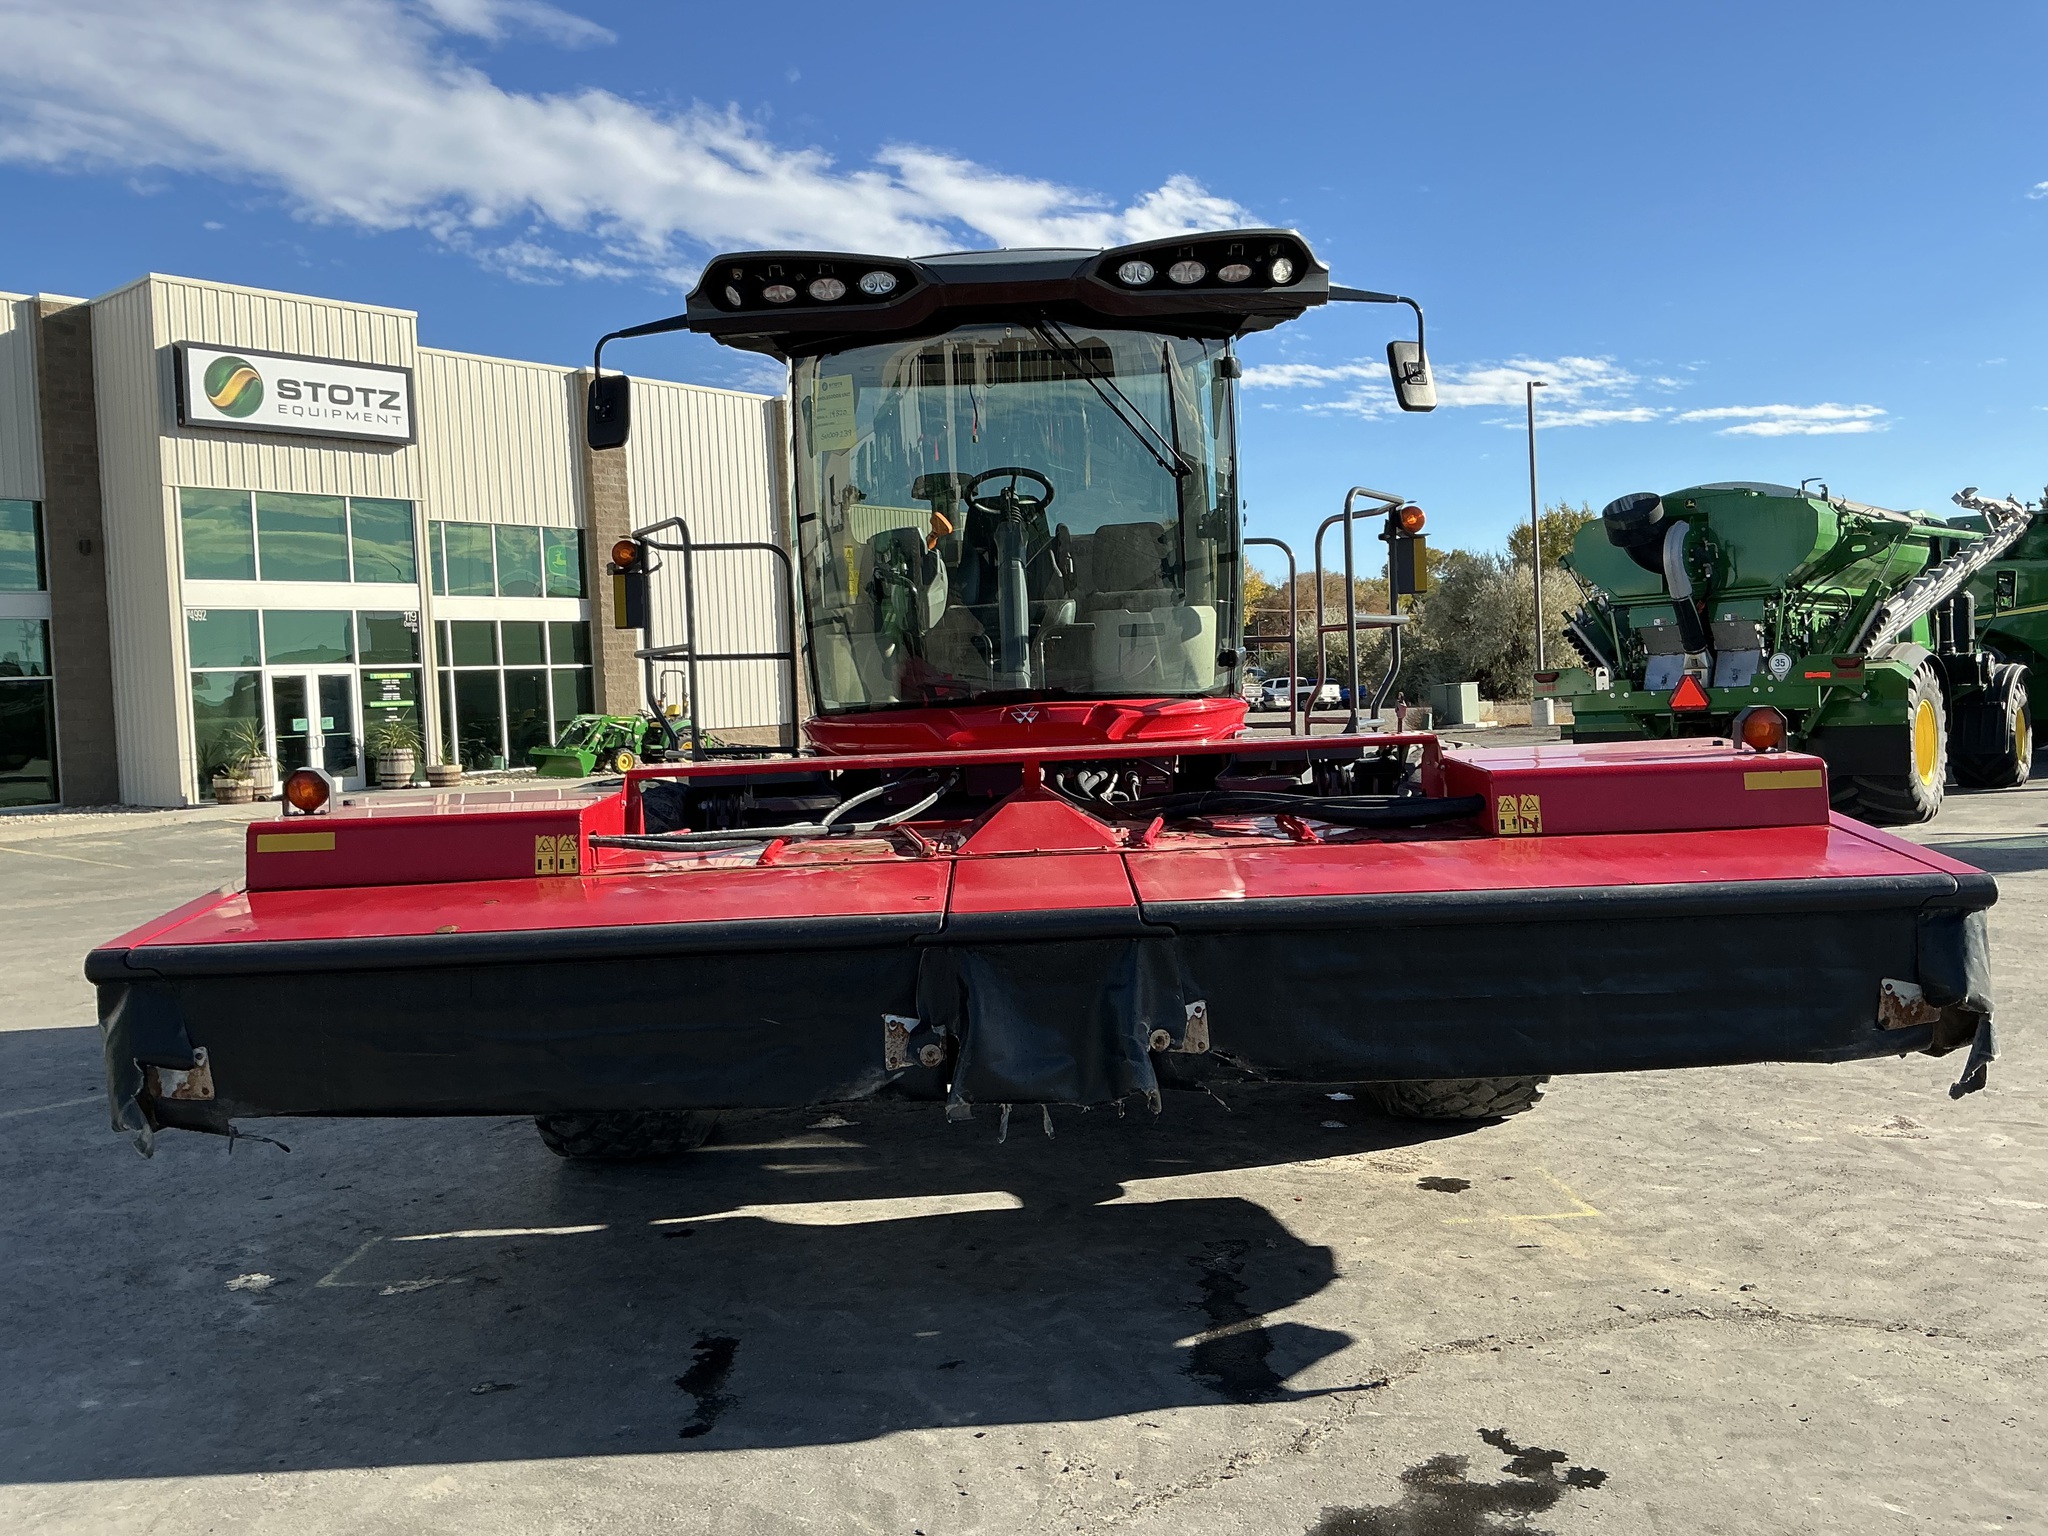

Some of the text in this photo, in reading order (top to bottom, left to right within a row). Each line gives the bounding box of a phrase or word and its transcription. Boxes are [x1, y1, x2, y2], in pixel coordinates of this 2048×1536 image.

[277, 379, 401, 411] STOTZ
[278, 404, 402, 425] EQUIPMENT
[403, 611, 417, 622] 119
[1774, 658, 1786, 667] 35
